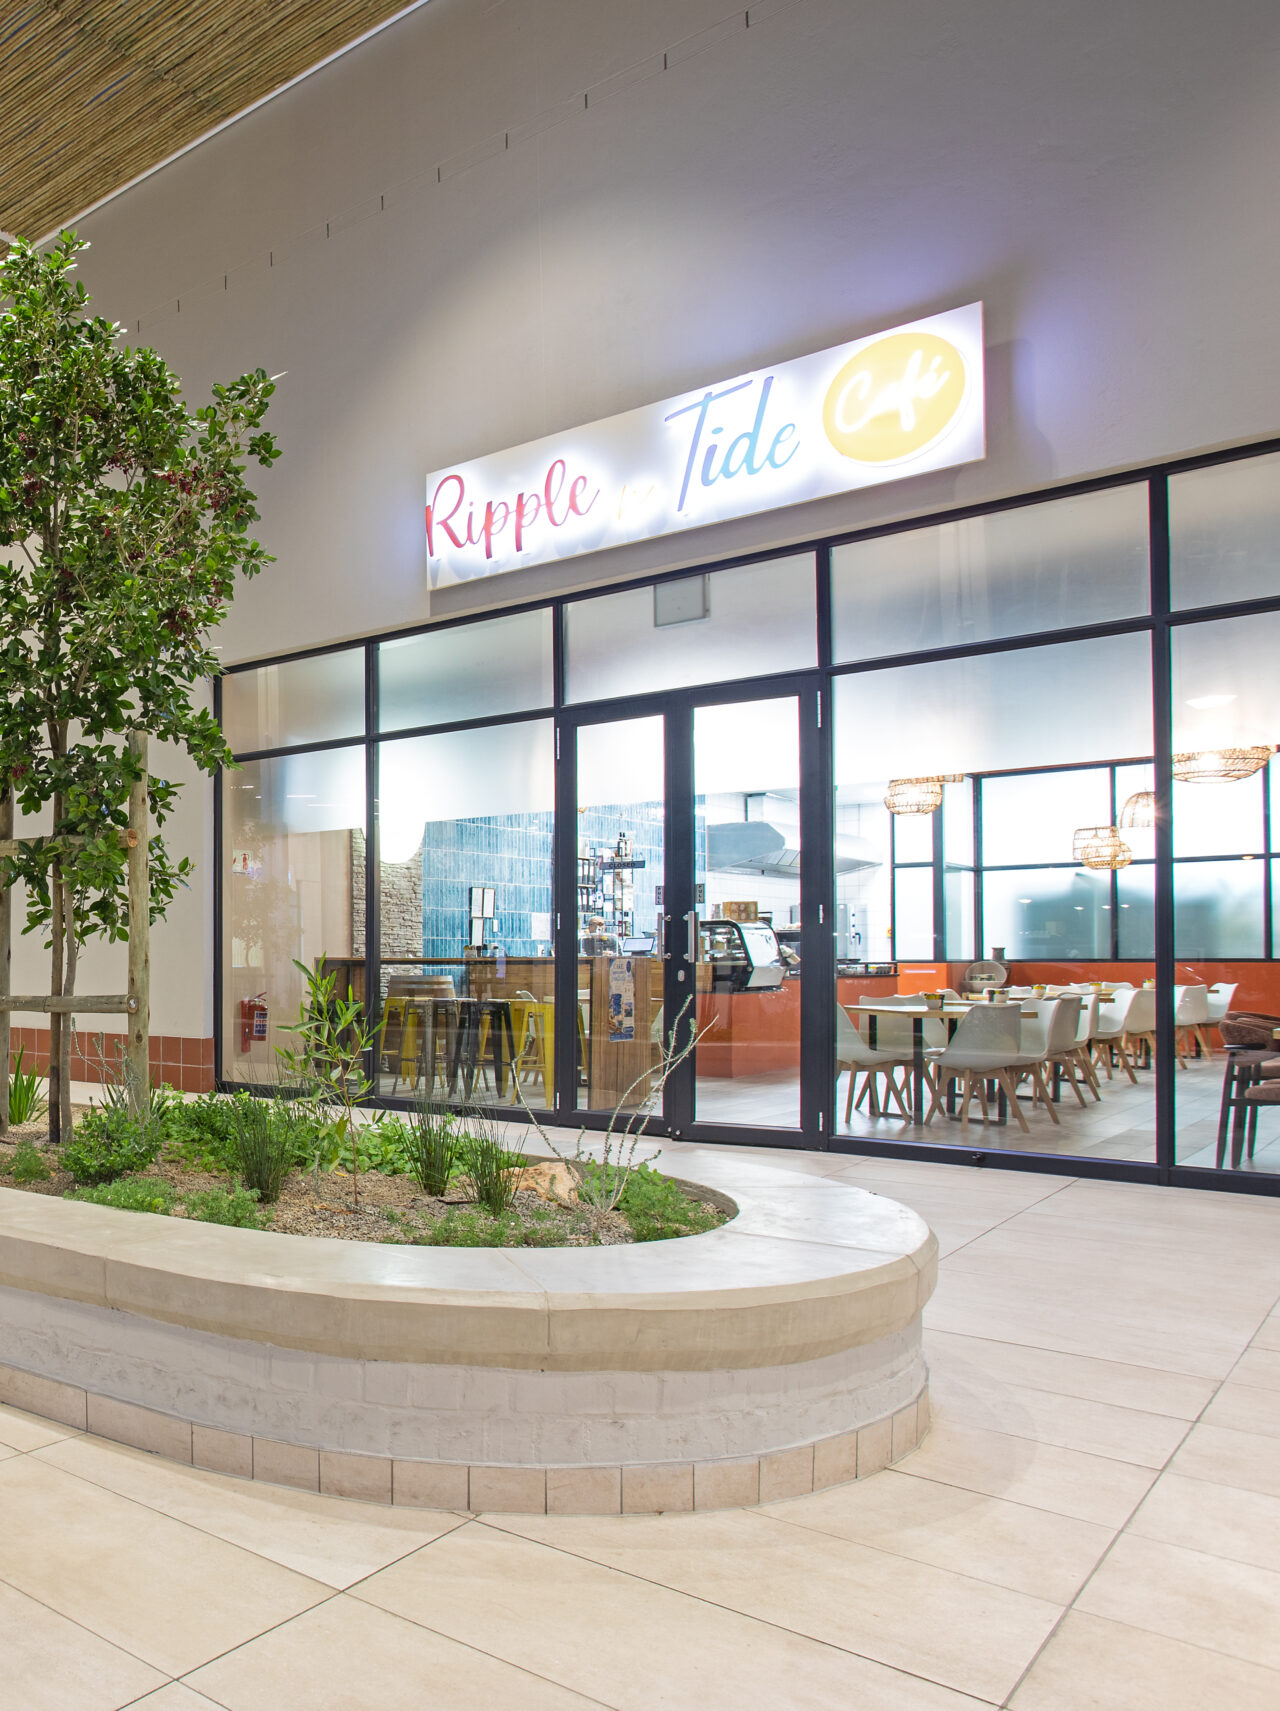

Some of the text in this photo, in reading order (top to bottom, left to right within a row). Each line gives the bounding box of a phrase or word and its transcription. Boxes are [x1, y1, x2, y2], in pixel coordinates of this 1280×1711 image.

[425, 459, 600, 559] Ripple
[664, 375, 800, 512] Tide
[833, 347, 951, 435] Café
